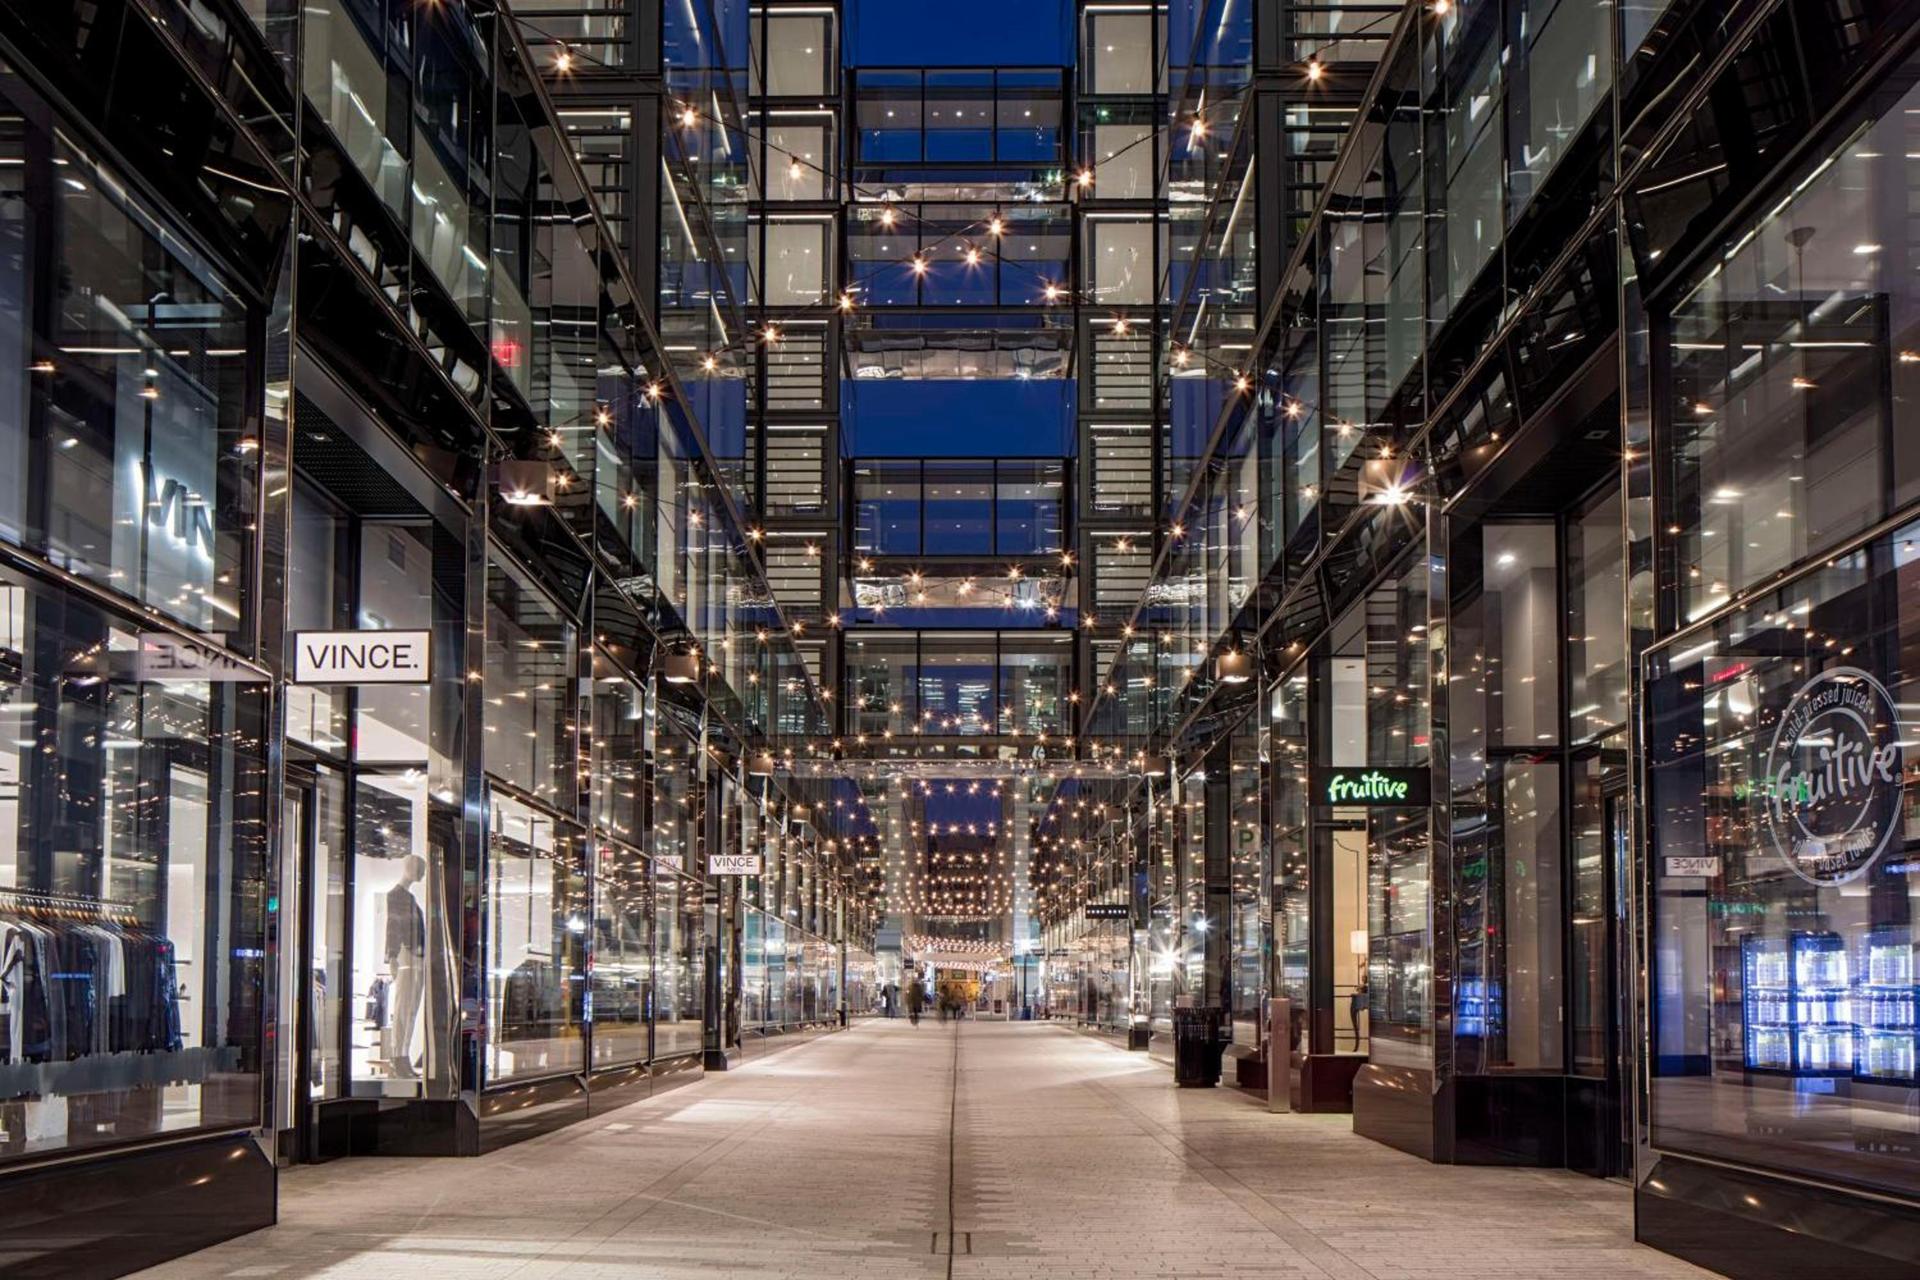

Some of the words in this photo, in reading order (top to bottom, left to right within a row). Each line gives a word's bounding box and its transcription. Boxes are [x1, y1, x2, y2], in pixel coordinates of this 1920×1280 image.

[307, 644, 418, 669] VINCE.
[1784, 683, 1840, 746] cold-pressed
[1840, 684, 1873, 714] juices
[1328, 771, 1408, 802] fruitive
[1773, 732, 1897, 823] fruitive
